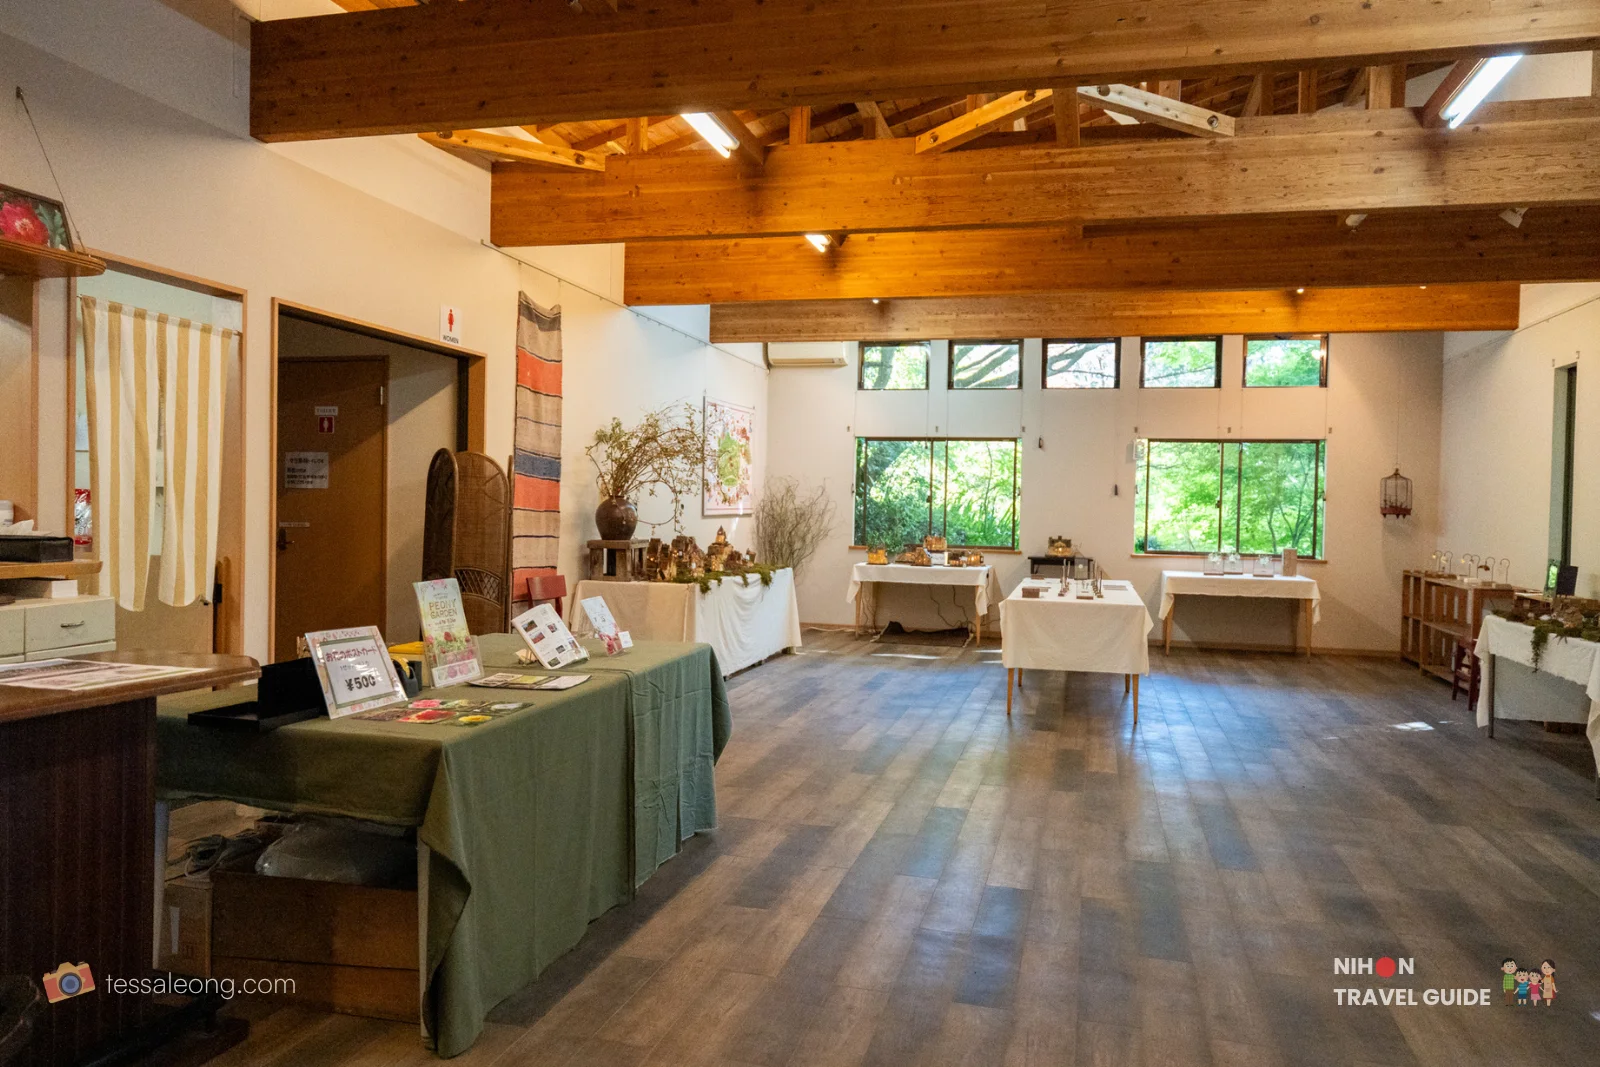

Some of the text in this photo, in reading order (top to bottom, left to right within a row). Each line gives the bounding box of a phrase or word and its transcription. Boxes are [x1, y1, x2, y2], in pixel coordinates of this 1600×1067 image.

[443, 335, 459, 344] WOMEN
[429, 599, 456, 610] PEONY
[431, 609, 457, 619] GARDEN
[345, 674, 376, 691] ¥500
